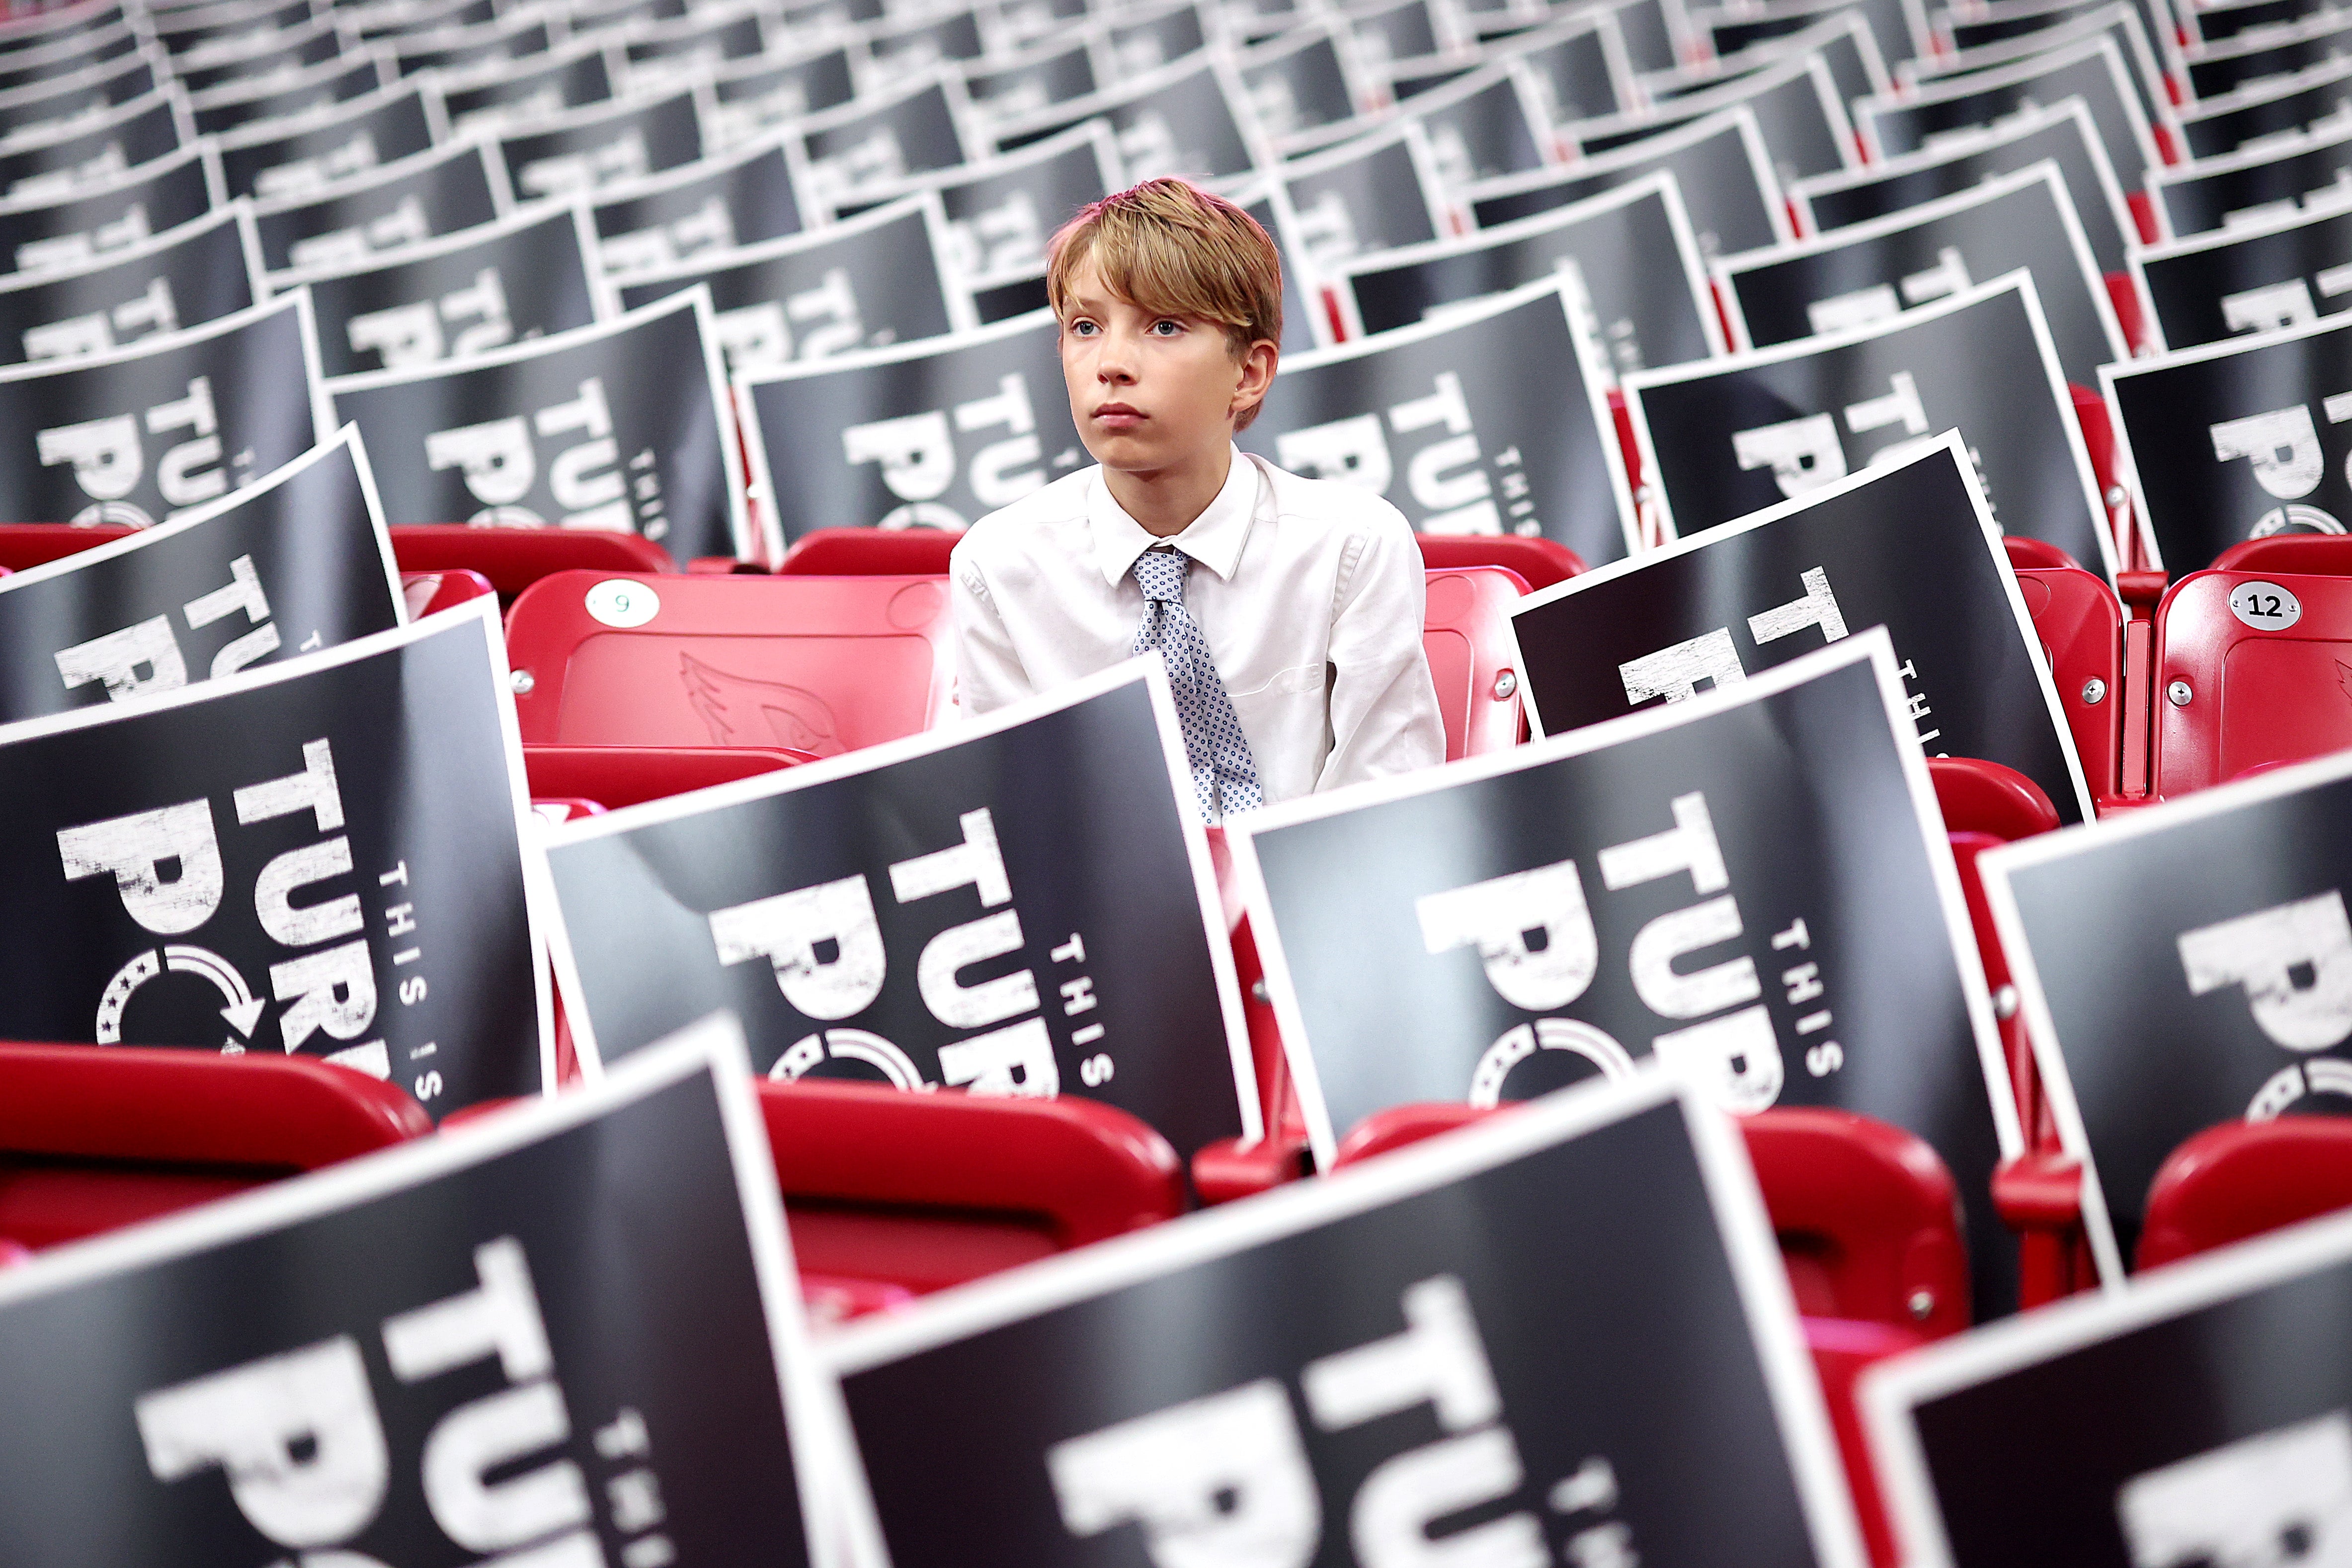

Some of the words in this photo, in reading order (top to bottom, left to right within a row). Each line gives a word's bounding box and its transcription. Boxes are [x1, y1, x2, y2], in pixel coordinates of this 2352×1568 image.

[615, 594, 630, 612] 9
[2247, 594, 2283, 618] 12
[378, 859, 428, 1007] THIS
[409, 1041, 443, 1101] IS
[1050, 932, 1115, 1087] THIS
[1771, 917, 1844, 1078] THIS
